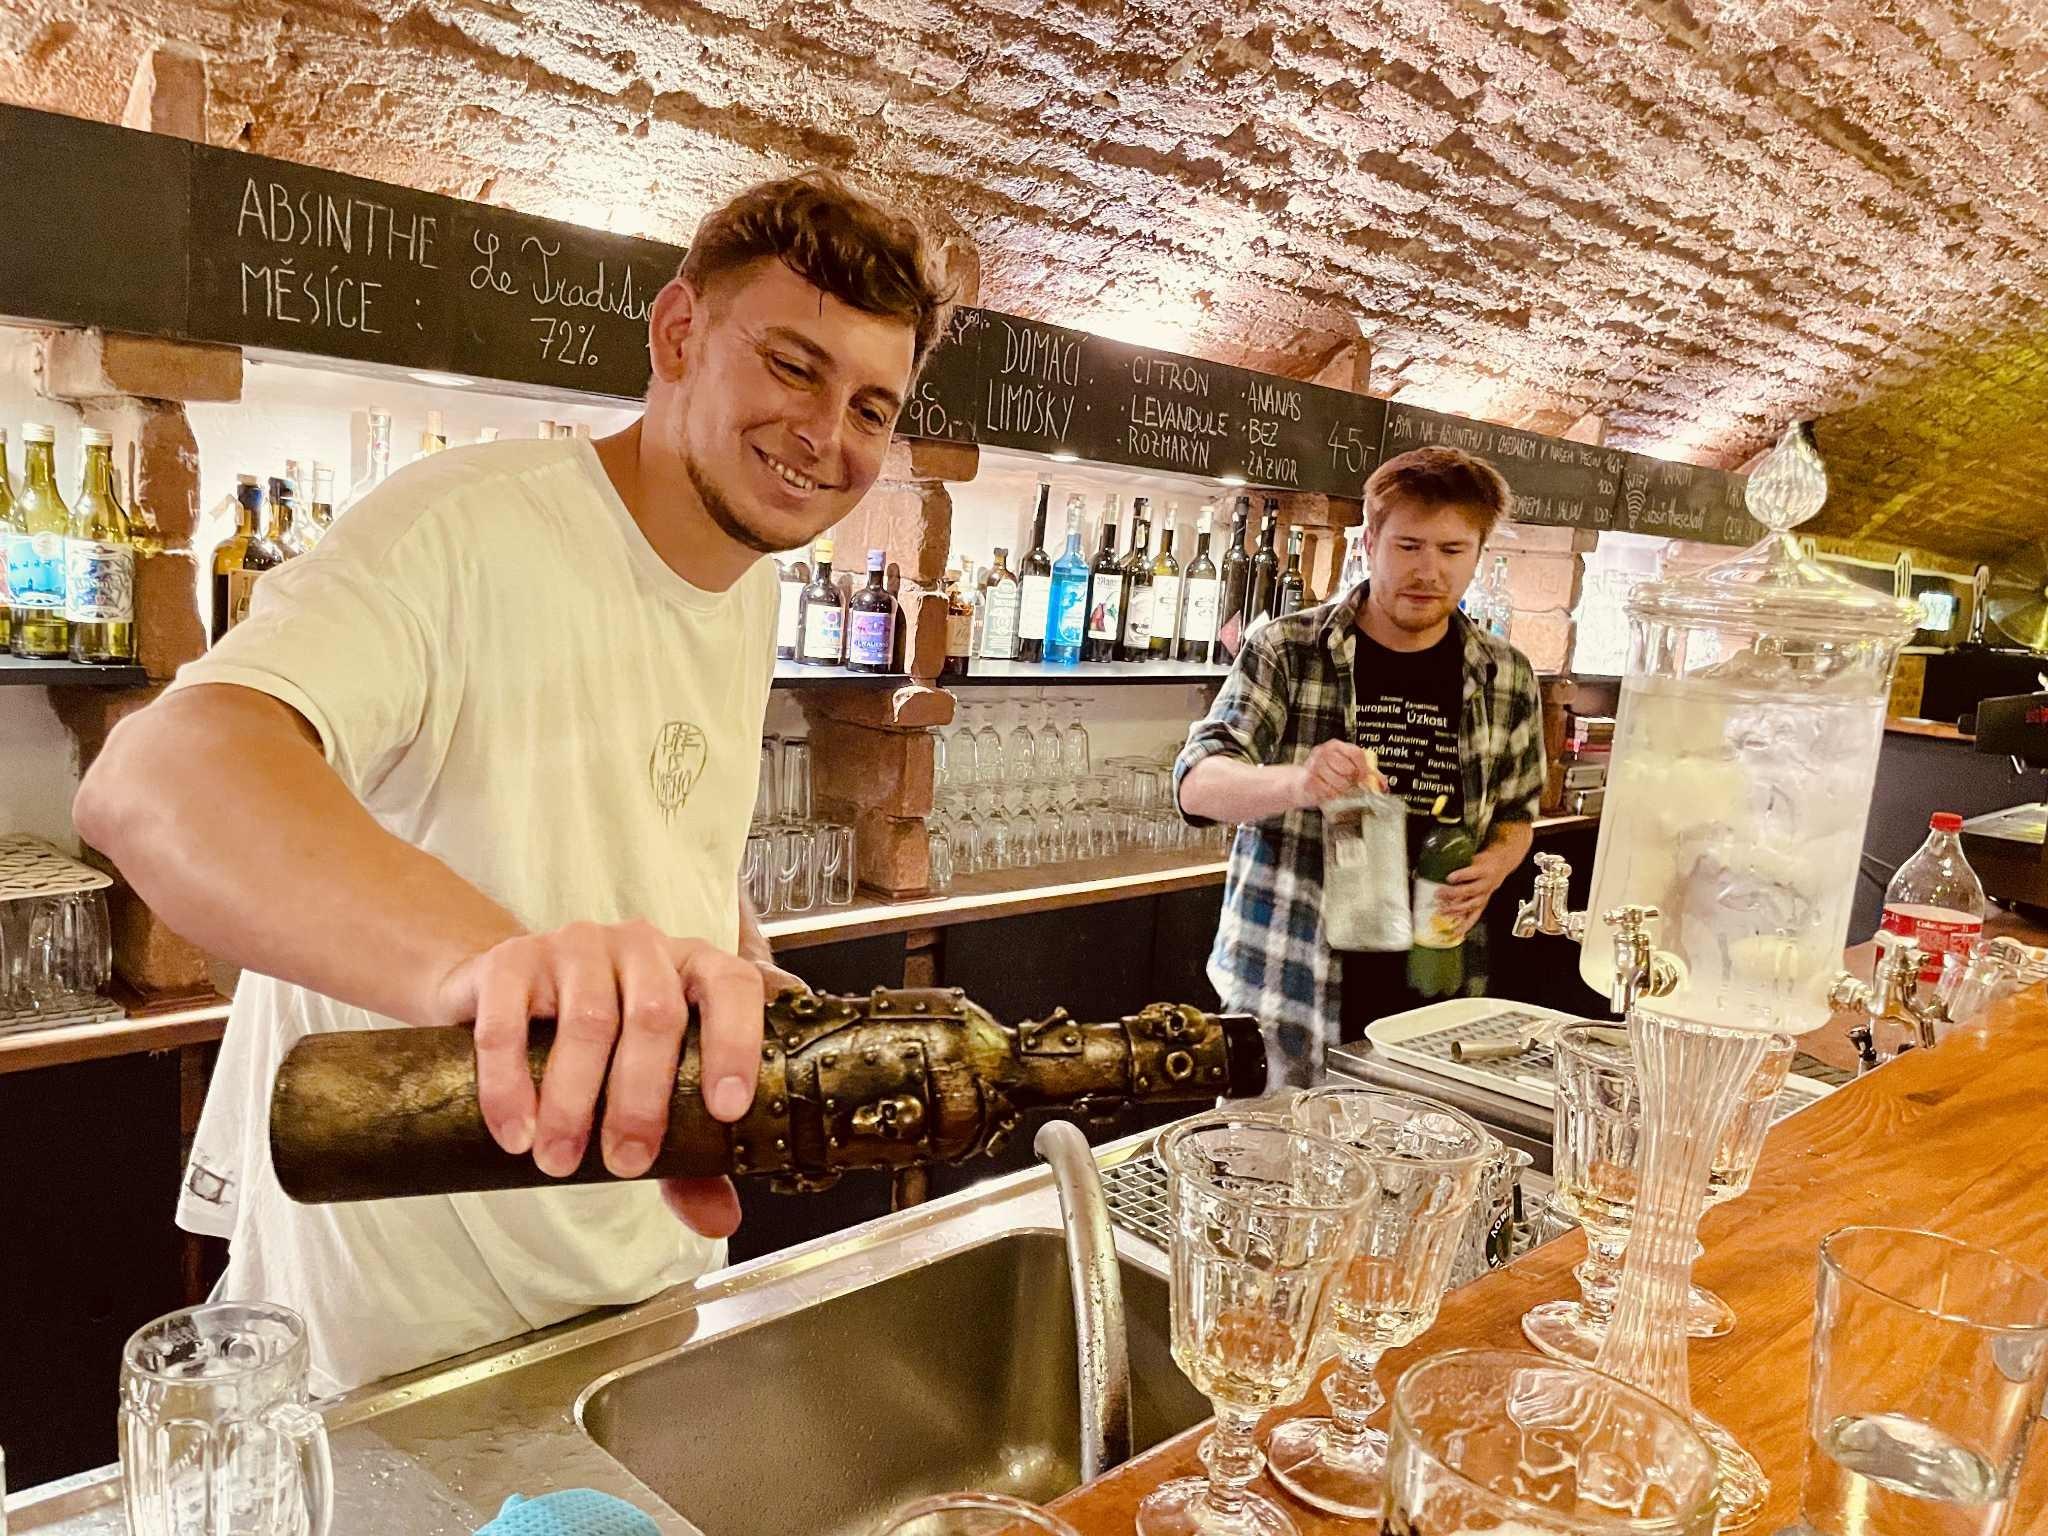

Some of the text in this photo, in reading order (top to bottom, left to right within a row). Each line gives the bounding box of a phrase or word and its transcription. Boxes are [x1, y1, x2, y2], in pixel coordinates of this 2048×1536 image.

[238, 177, 440, 270] ABSINTHE
[471, 229, 520, 295] Le
[241, 258, 383, 334] MĚSÍCE
[530, 317, 599, 366] 72%
[1000, 320, 1089, 387] DOMÁCÍ
[1133, 355, 1209, 397] CITRON
[987, 379, 1075, 443] LIMOŠKY
[1131, 394, 1229, 437] LEVANDULE
[1247, 381, 1301, 422] ANANAS
[1249, 418, 1279, 447] BEZ
[1406, 710, 1449, 728] Úzkost
